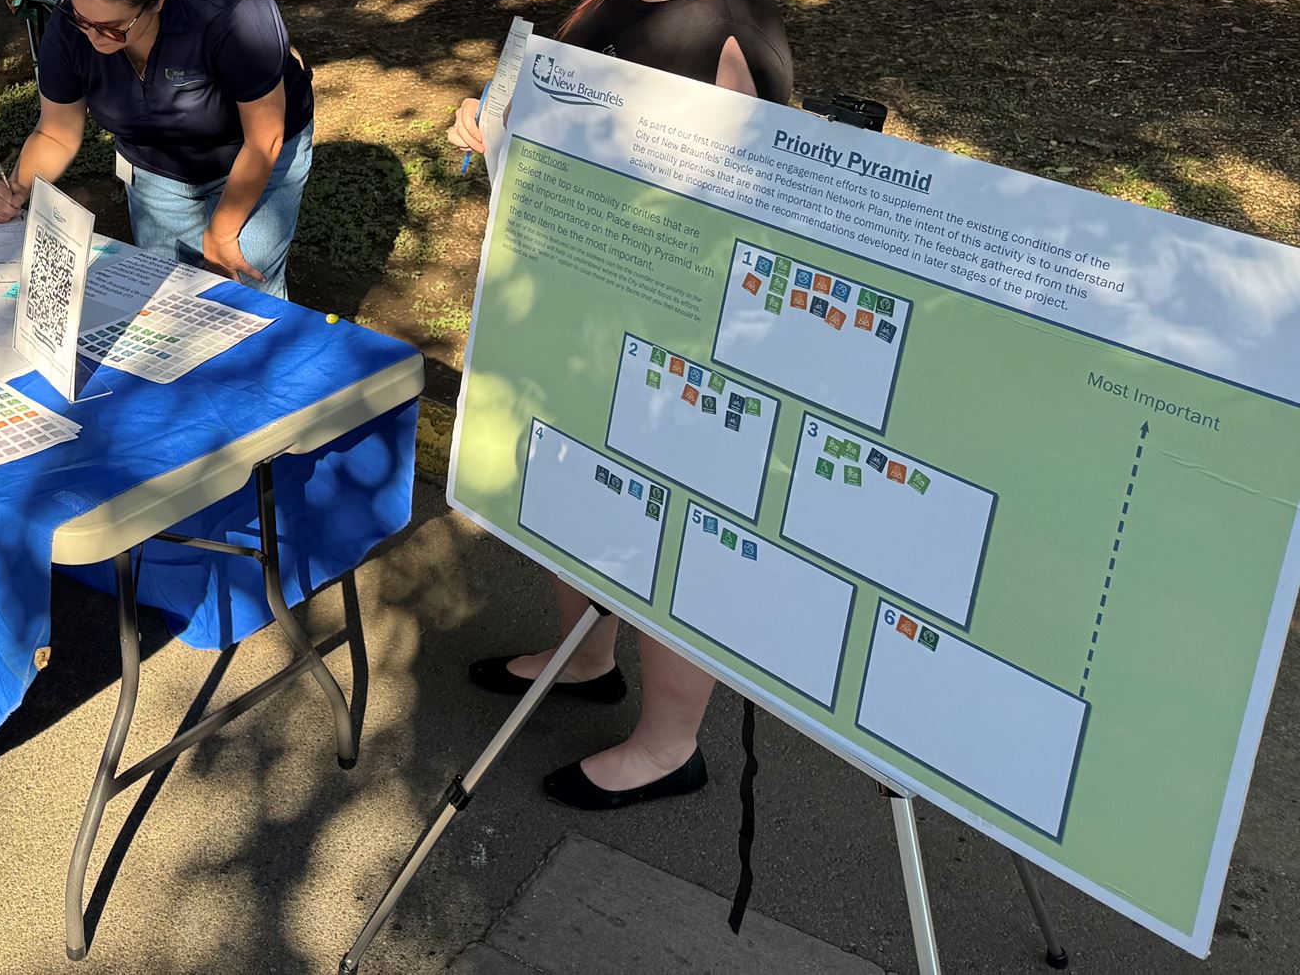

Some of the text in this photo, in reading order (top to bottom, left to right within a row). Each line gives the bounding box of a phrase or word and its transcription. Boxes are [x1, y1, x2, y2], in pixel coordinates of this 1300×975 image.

[552, 77, 624, 107] New Braunfels
[554, 66, 566, 77] City
[522, 146, 569, 171] Instructions:
[774, 129, 932, 193] Priority Pyramid
[515, 178, 698, 255] most important to you. Place each sticker in
[517, 160, 700, 238] Select the top six mobility priorities that are
[632, 143, 645, 154] the
[646, 149, 678, 166] mobility
[678, 159, 715, 177] priorities
[717, 171, 734, 183] that
[736, 178, 750, 189] are
[752, 184, 775, 197] most
[776, 189, 822, 212] important
[824, 205, 833, 215] to
[835, 209, 851, 222] the
[853, 216, 909, 242] community.
[914, 233, 933, 248] The
[980, 258, 1032, 280] gathered
[1034, 273, 1061, 290] from
[1065, 283, 1087, 298] this
[635, 129, 650, 142] City
[651, 136, 660, 144] of
[661, 138, 678, 150] New
[724, 157, 754, 174] Bicycle
[755, 164, 773, 181] and
[774, 173, 823, 197] Pedestrian
[825, 189, 865, 211] Network
[867, 203, 891, 221] Plan,
[895, 213, 912, 225] the
[914, 218, 944, 236] intent
[947, 230, 959, 240] of
[961, 234, 981, 247] this
[983, 242, 1024, 262] activity
[1026, 253, 1036, 265] is
[1039, 258, 1050, 269] to
[1054, 264, 1124, 292] understand
[638, 117, 648, 126] As
[649, 122, 666, 132] part
[678, 131, 691, 139] our
[694, 134, 708, 145] first
[711, 141, 735, 154] round
[735, 148, 747, 158] of
[747, 152, 774, 167] public
[776, 161, 834, 185] engagement
[835, 179, 867, 195] efforts
[870, 189, 880, 199] to
[882, 194, 943, 219] supplement
[946, 212, 963, 225] the
[966, 220, 1009, 241] existing
[1011, 233, 1071, 258] conditions
[1074, 253, 1088, 263] of
[1090, 256, 1110, 270] the
[510, 205, 653, 271] the top item be the most important.
[512, 191, 714, 278] order of importance on the Priority Pyramid with
[630, 157, 656, 173] activity
[658, 167, 671, 176] will
[673, 170, 683, 180] be
[736, 191, 753, 204] into
[755, 198, 769, 210] the
[771, 205, 855, 239] recommendations
[857, 233, 909, 256] developed
[911, 250, 920, 261] in
[923, 253, 948, 269] later
[950, 264, 986, 285] stages
[989, 277, 1002, 287] of
[1003, 281, 1022, 294] the
[1024, 289, 1067, 310] project.
[742, 251, 752, 266] 1
[628, 343, 638, 356] 2
[807, 422, 818, 437] 3
[1088, 372, 1220, 431] Most Important
[535, 427, 543, 440] 4
[692, 509, 701, 524] 5
[884, 609, 896, 625] 6
